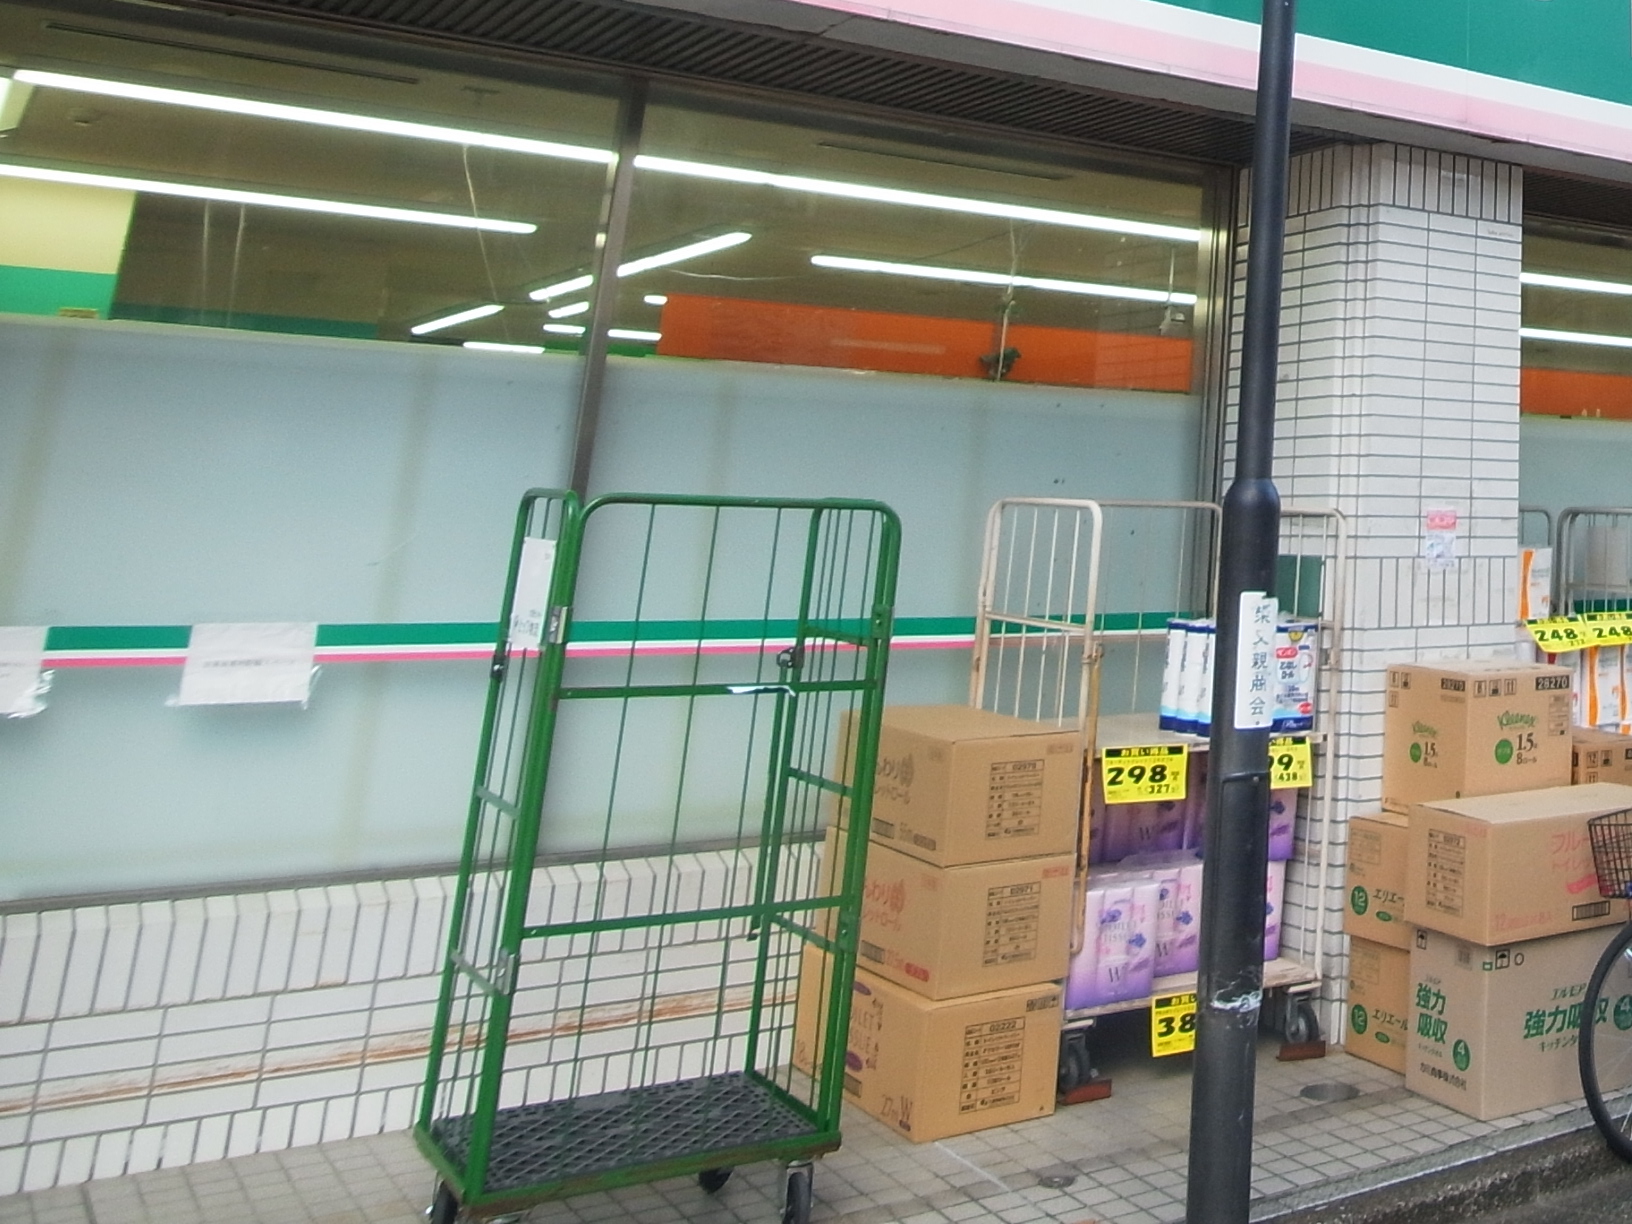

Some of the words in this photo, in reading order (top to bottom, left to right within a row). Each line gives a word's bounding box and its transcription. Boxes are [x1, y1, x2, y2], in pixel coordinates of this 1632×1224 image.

[1534, 628, 1578, 642] 248
[1537, 676, 1568, 690] 28270
[1106, 764, 1168, 787] 298
[1354, 890, 1366, 907] 12
[1373, 887, 1405, 907] エリエー
[1416, 982, 1446, 1016] 強力
[1353, 1010, 1365, 1027] 12
[1417, 1013, 1448, 1045] 吸収
